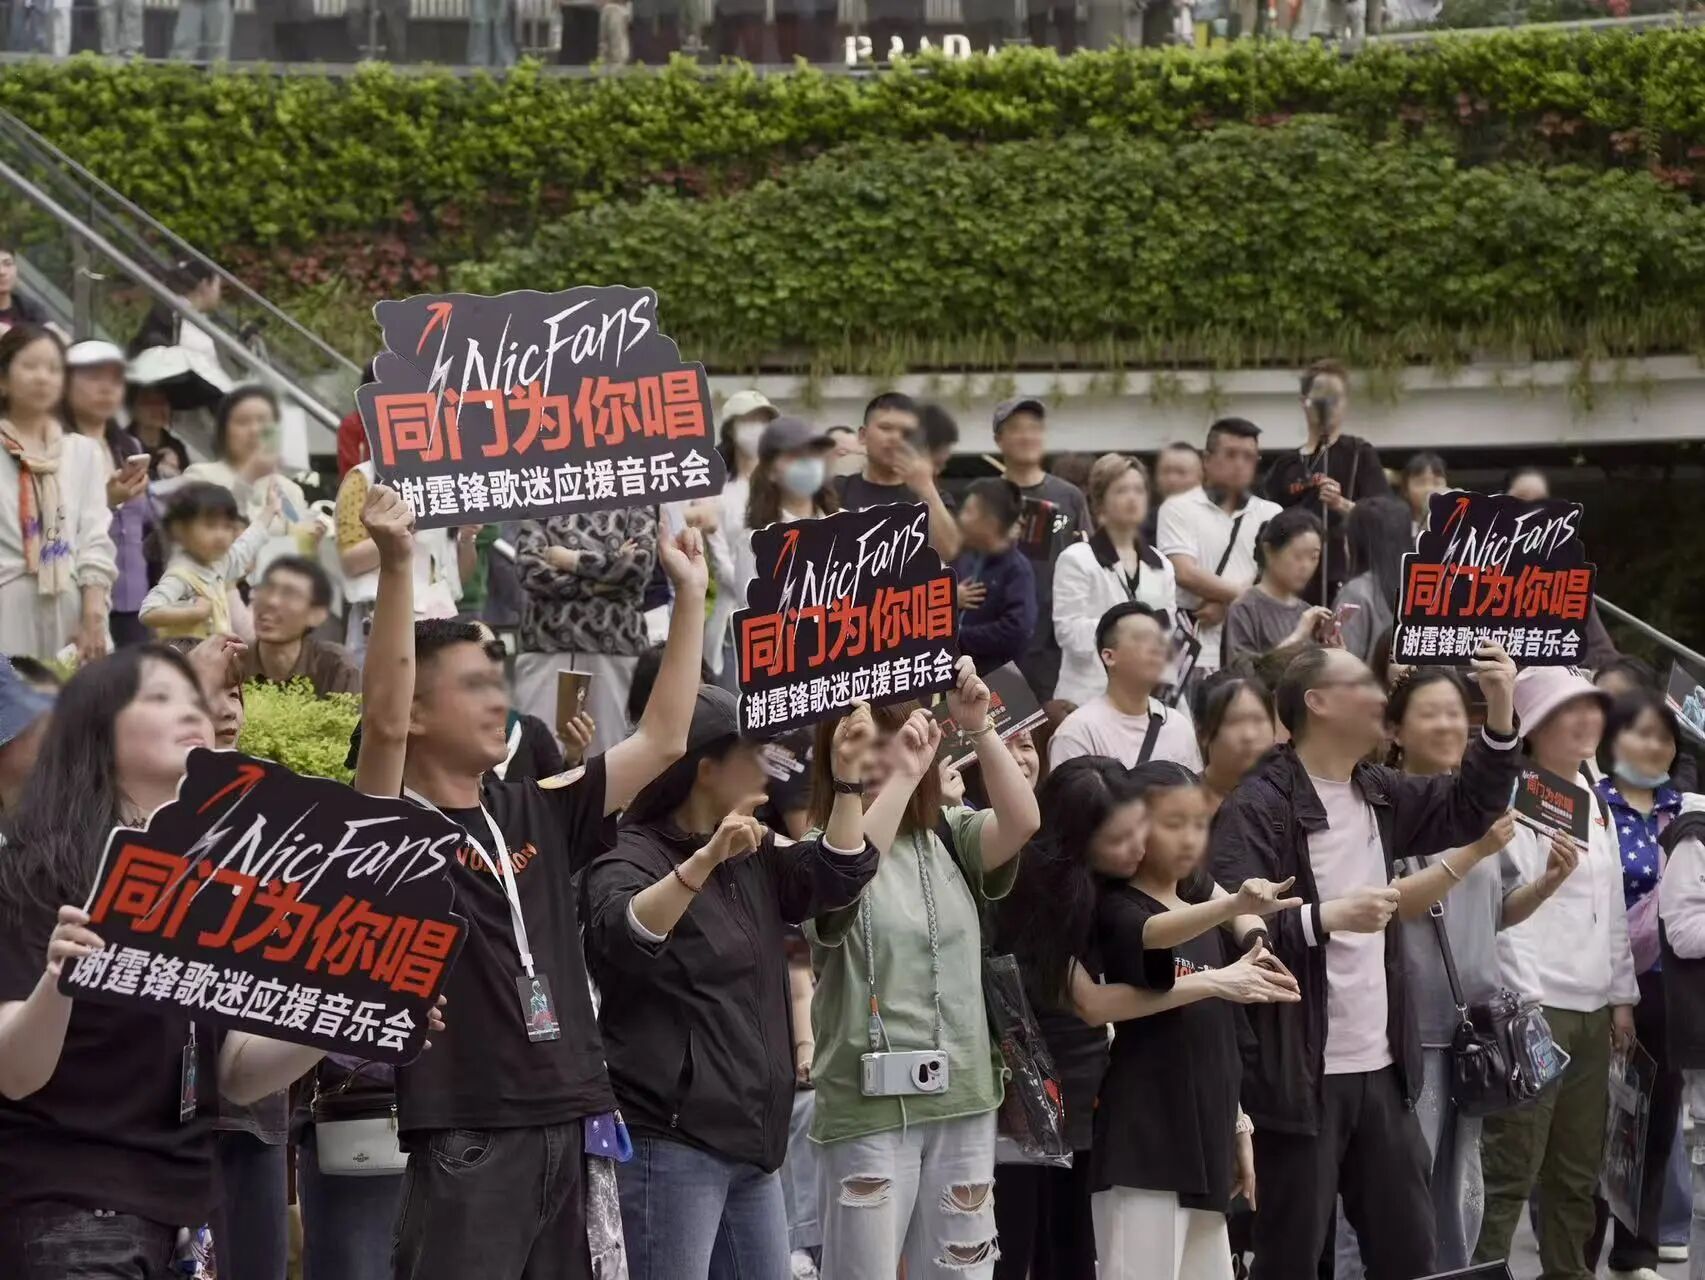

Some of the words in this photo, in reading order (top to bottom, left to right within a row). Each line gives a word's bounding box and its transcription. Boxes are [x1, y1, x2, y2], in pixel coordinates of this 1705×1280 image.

[457, 296, 650, 431] NicFans
[376, 370, 706, 466] 同门为你唱
[392, 449, 711, 518] 谢霆锋歌迷应援音乐会
[794, 512, 926, 641] NicFans
[1405, 563, 1592, 620] 同门为你唱
[1450, 508, 1579, 594] NicFans
[742, 577, 954, 683] 同门为你唱
[746, 648, 954, 729] 谢霆锋歌迷应援音乐会
[188, 802, 460, 909] NicFans
[89, 843, 459, 999] 同门为你唱
[68, 943, 417, 1052] 谢霆锋歌迷应援音乐会
